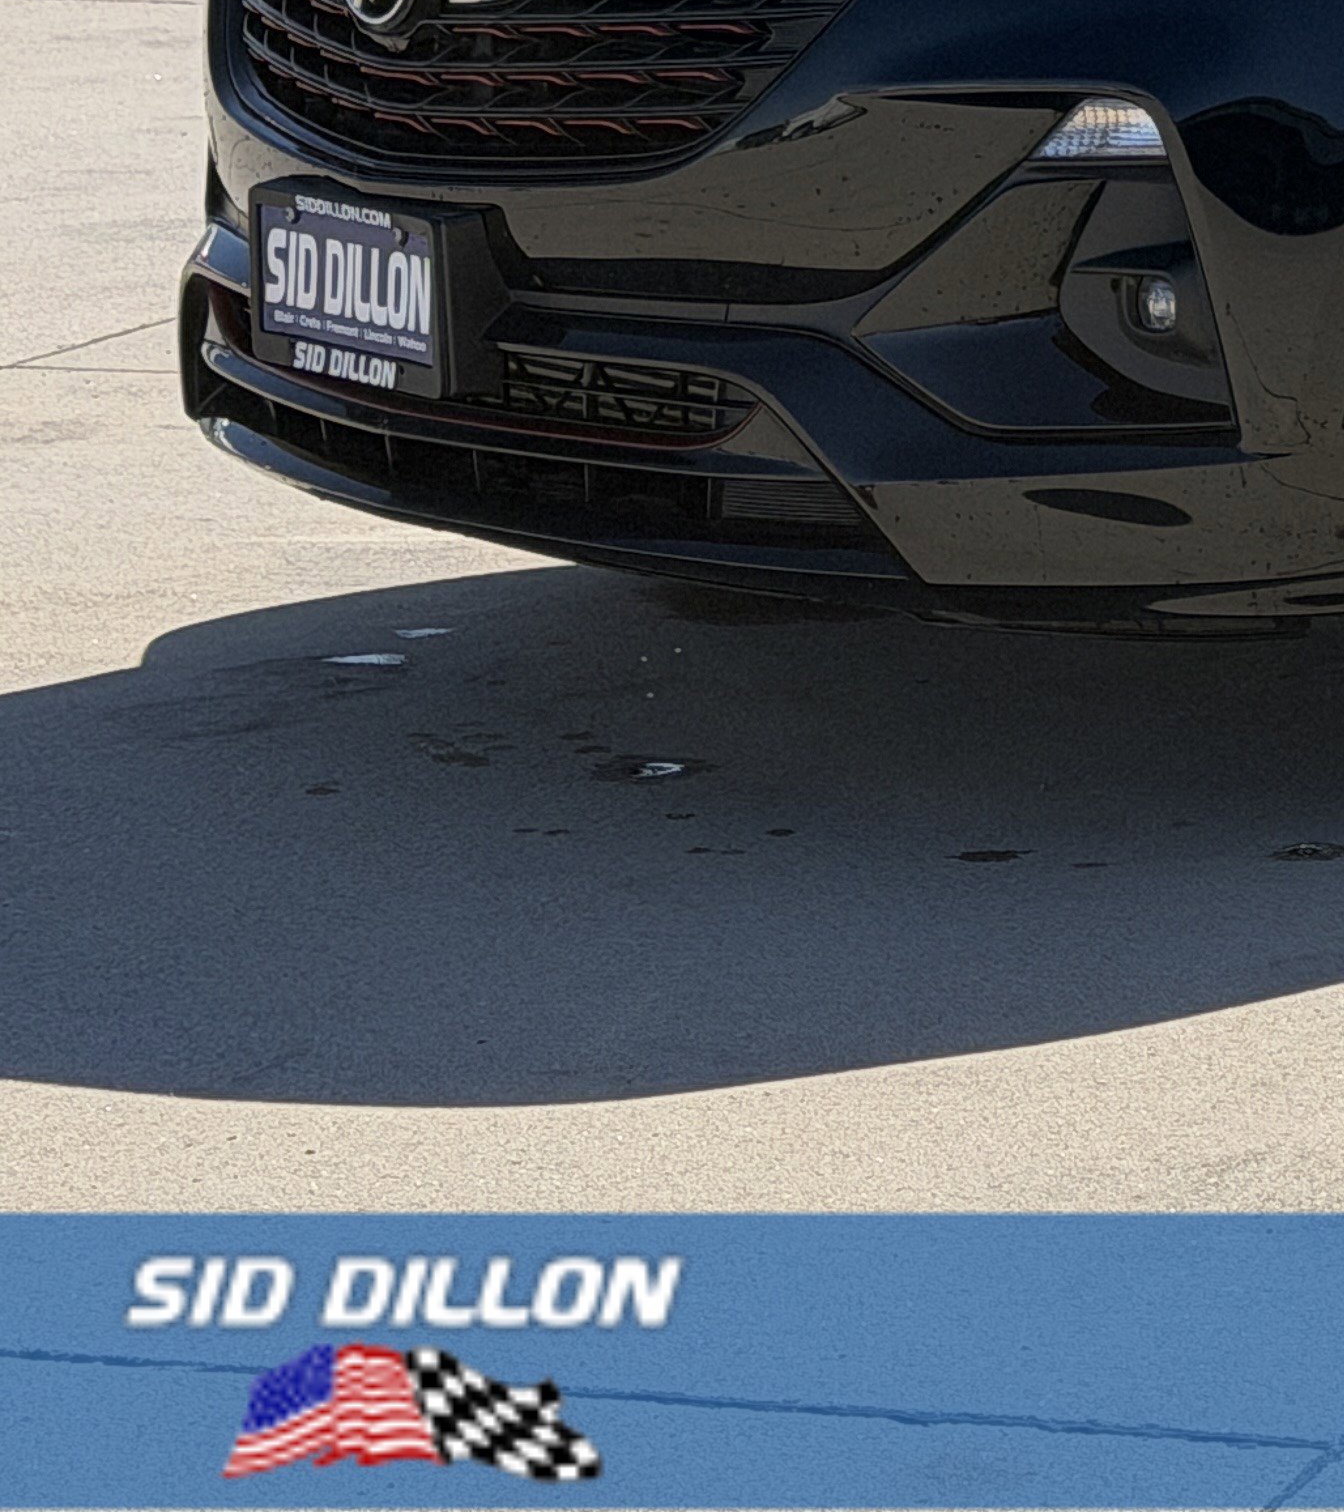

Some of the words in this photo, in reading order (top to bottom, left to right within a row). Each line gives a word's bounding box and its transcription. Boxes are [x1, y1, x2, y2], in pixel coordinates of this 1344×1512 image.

[295, 194, 391, 229] SIDDILLON.COM
[264, 228, 318, 310] SID
[324, 238, 431, 335] DILLON
[293, 341, 326, 374] SID
[328, 349, 397, 389] DILLON
